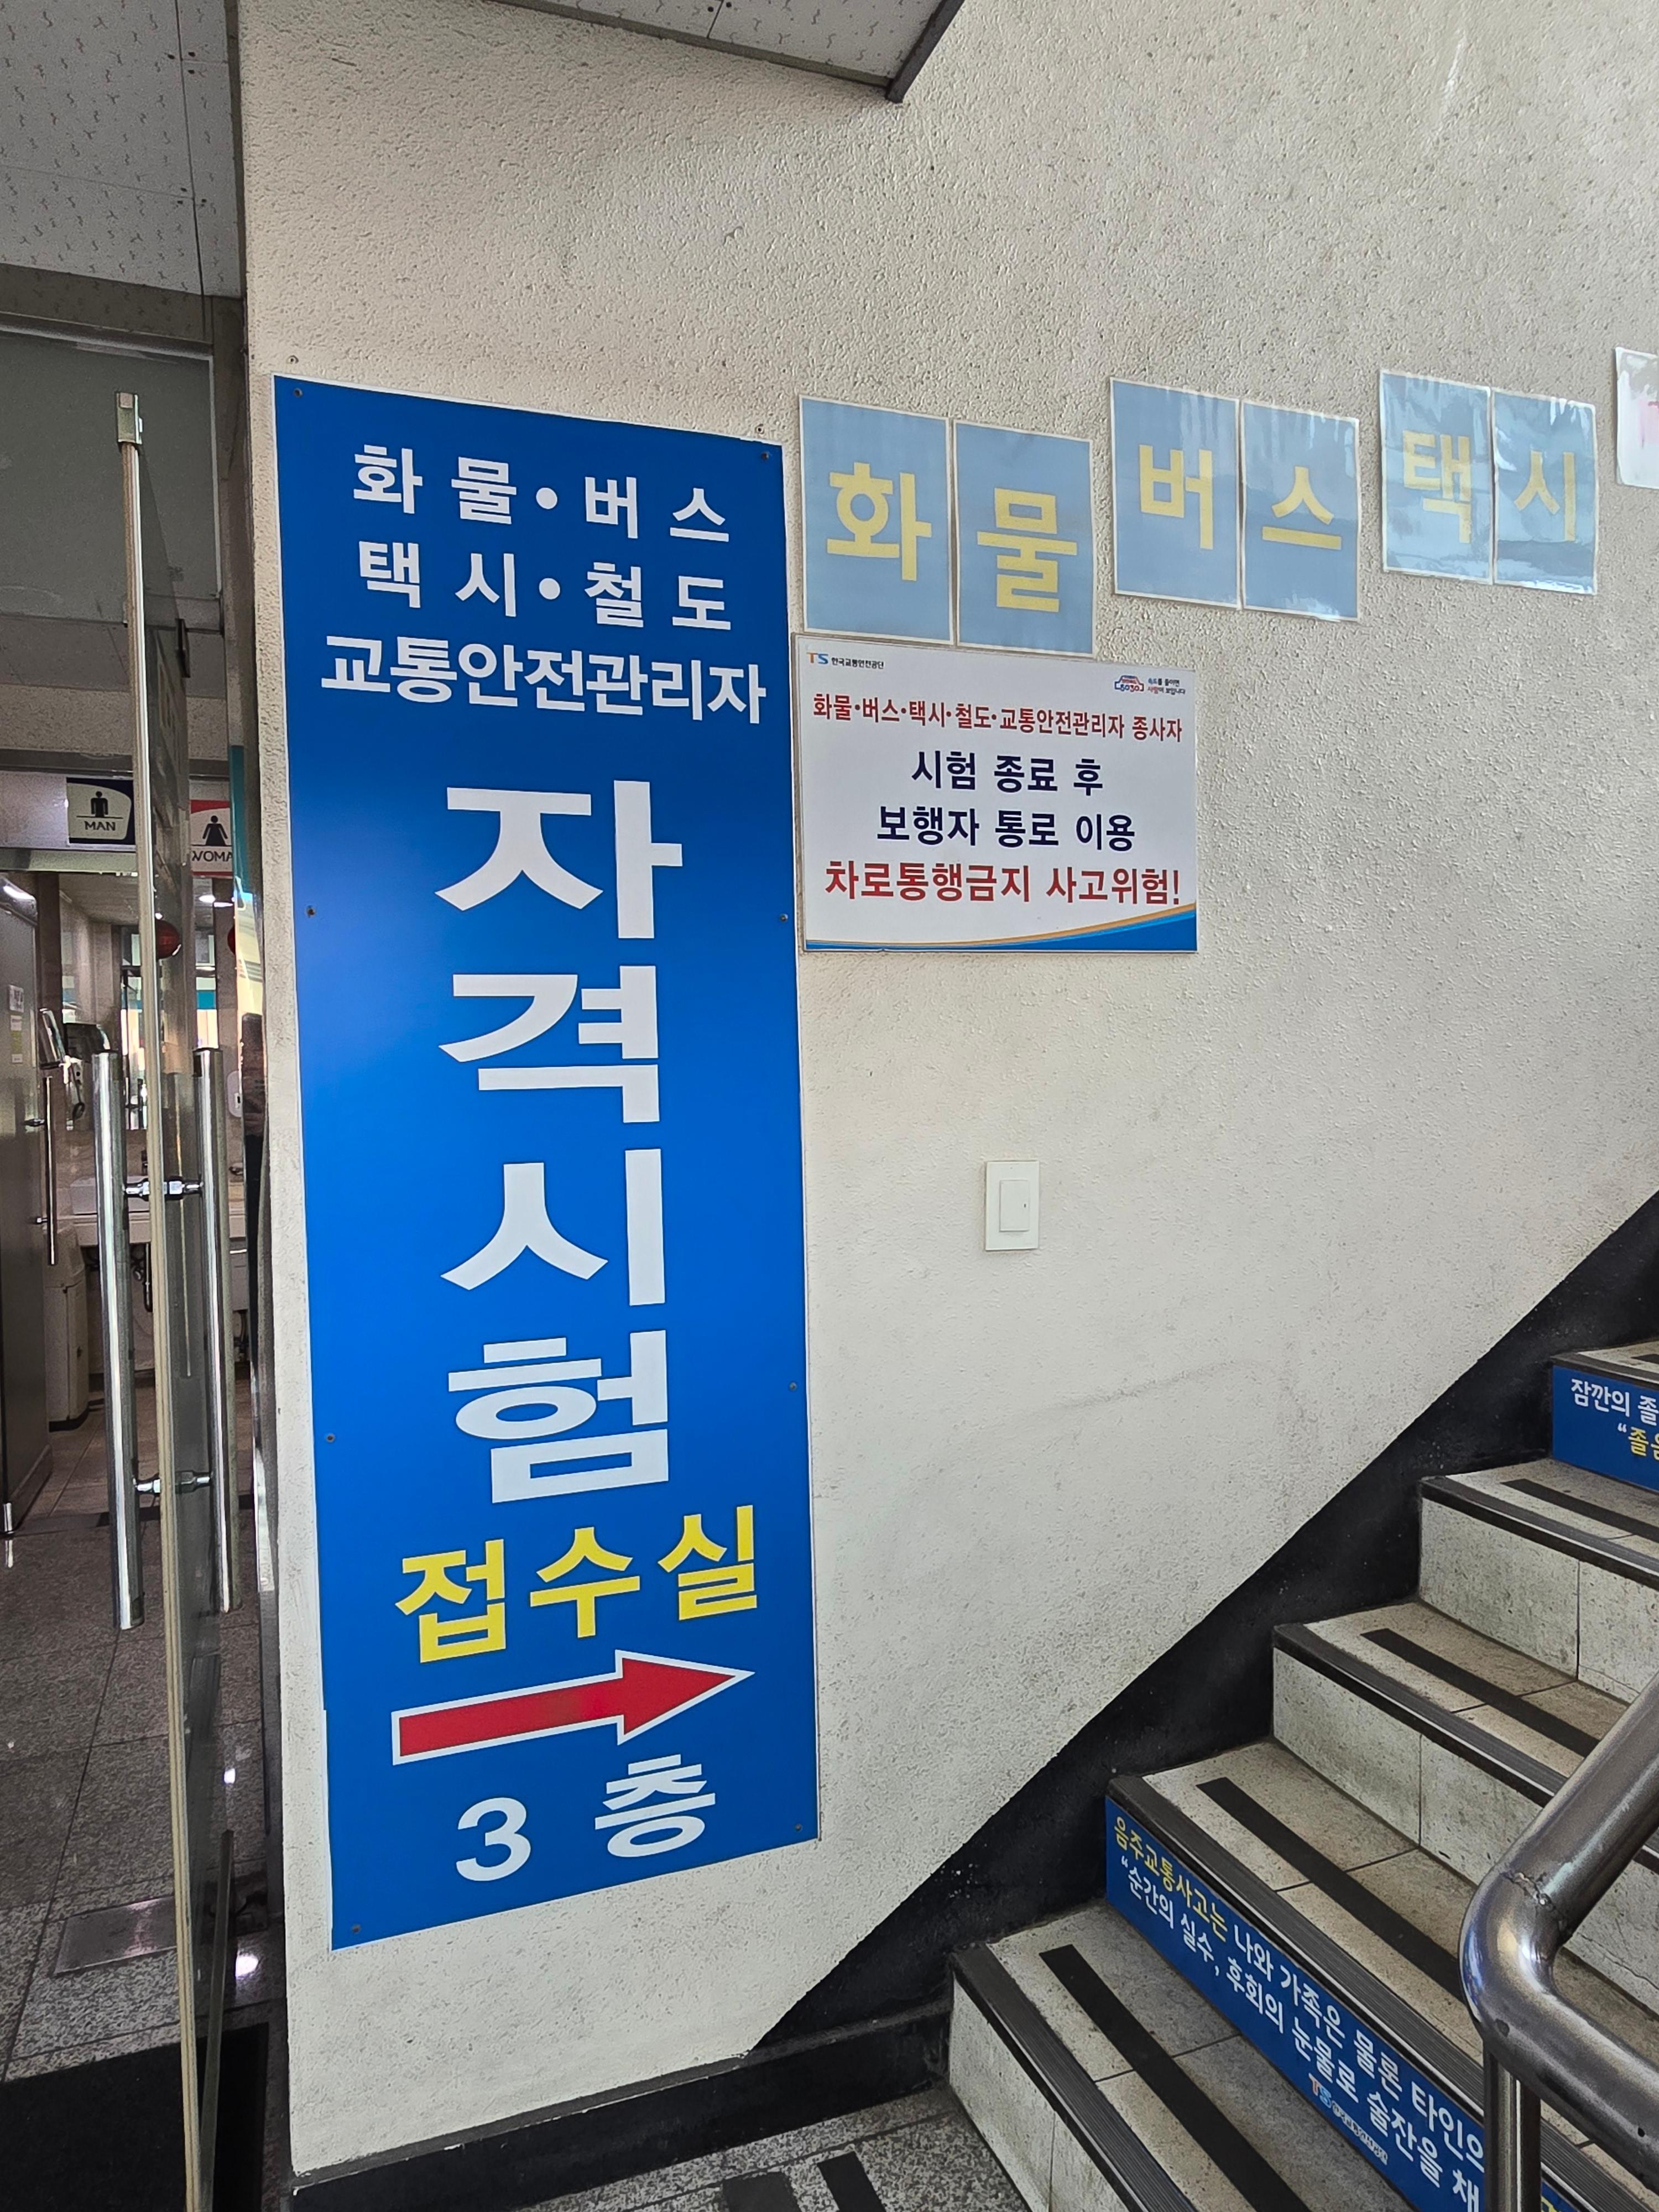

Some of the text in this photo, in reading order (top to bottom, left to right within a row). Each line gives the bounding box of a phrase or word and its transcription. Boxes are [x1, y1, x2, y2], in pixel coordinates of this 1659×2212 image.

[1139, 444, 1342, 551] 버스
[1403, 430, 1575, 544] 택시
[827, 461, 1077, 612] 화물
[321, 635, 767, 724] 교통안전관리자
[806, 652, 828, 665] TS
[1131, 715, 1183, 743] 종사자
[911, 749, 1103, 796] 시험 종료 후
[84, 821, 116, 831] MAN
[191, 851, 233, 862] WOMA
[877, 805, 1136, 852] 보행자 통로 이용
[825, 859, 1180, 905] 차로통행금지 사고위험!
[435, 780, 684, 1504] 자격시험
[1571, 1378, 1630, 1417] 잠깐의
[395, 1505, 758, 1663] 접수실
[1114, 1816, 1228, 1943] 음주교통사고는
[1234, 1924, 1274, 1982] 나와
[1280, 1964, 1346, 2049] 가족은
[1353, 2029, 1403, 2102] 물론
[1226, 1956, 1284, 2034] 후회의
[1291, 2016, 1359, 2104] 눈물로
[1366, 2091, 1443, 2189] 술잔을
